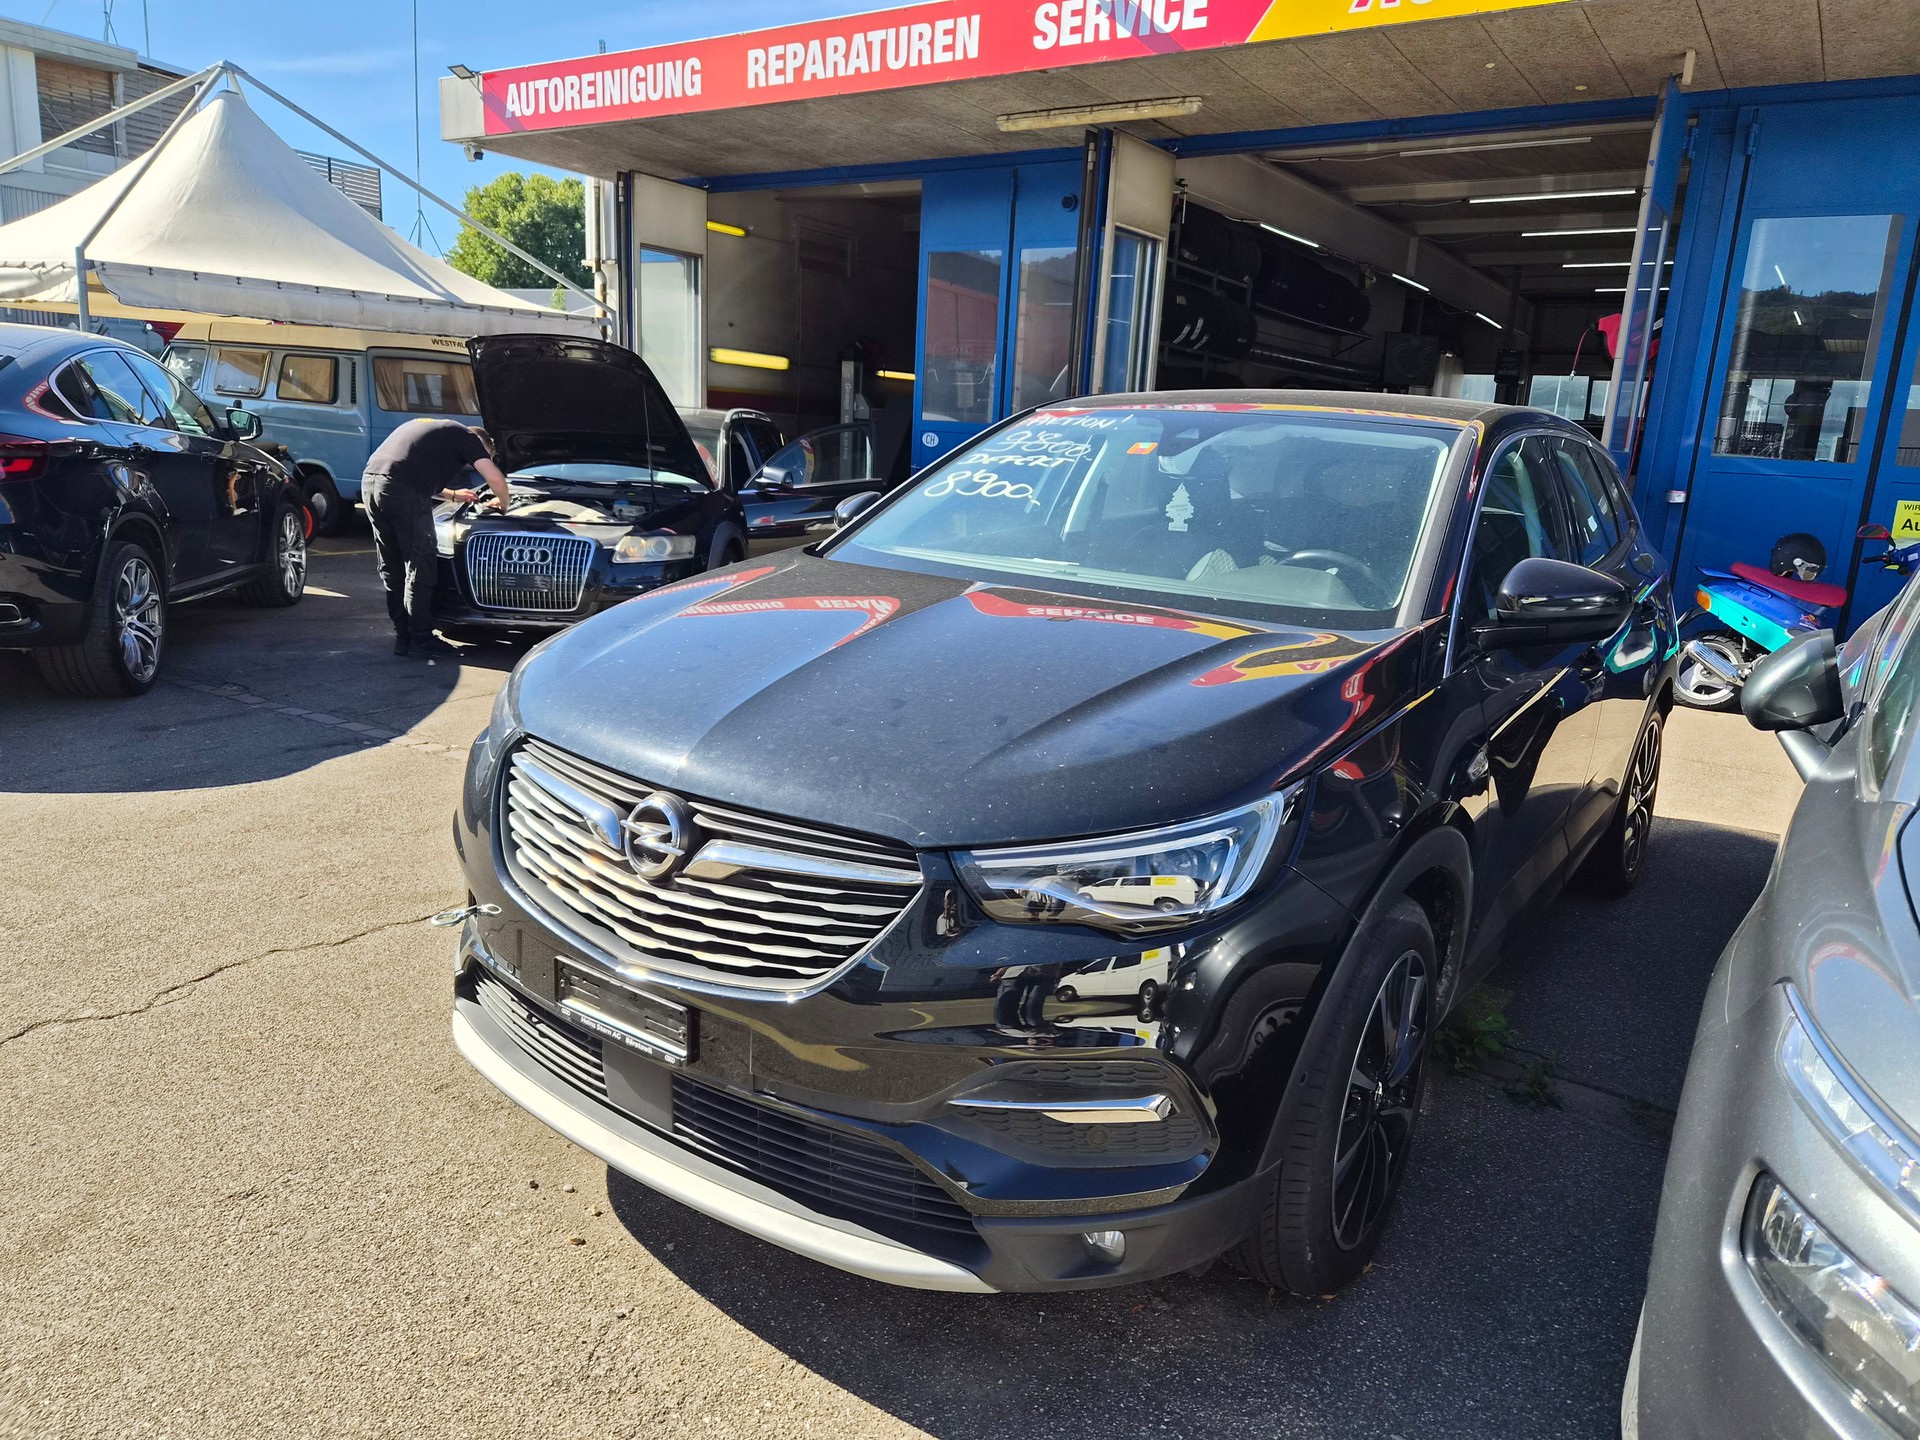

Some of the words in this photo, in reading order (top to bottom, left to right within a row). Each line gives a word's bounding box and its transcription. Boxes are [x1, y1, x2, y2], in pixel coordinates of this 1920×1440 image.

[505, 57, 701, 118] AUTOREINIGUNG
[747, 14, 980, 89] REPARATUREN
[1033, 0, 1208, 50] SERVICE
[925, 434, 936, 445] CH
